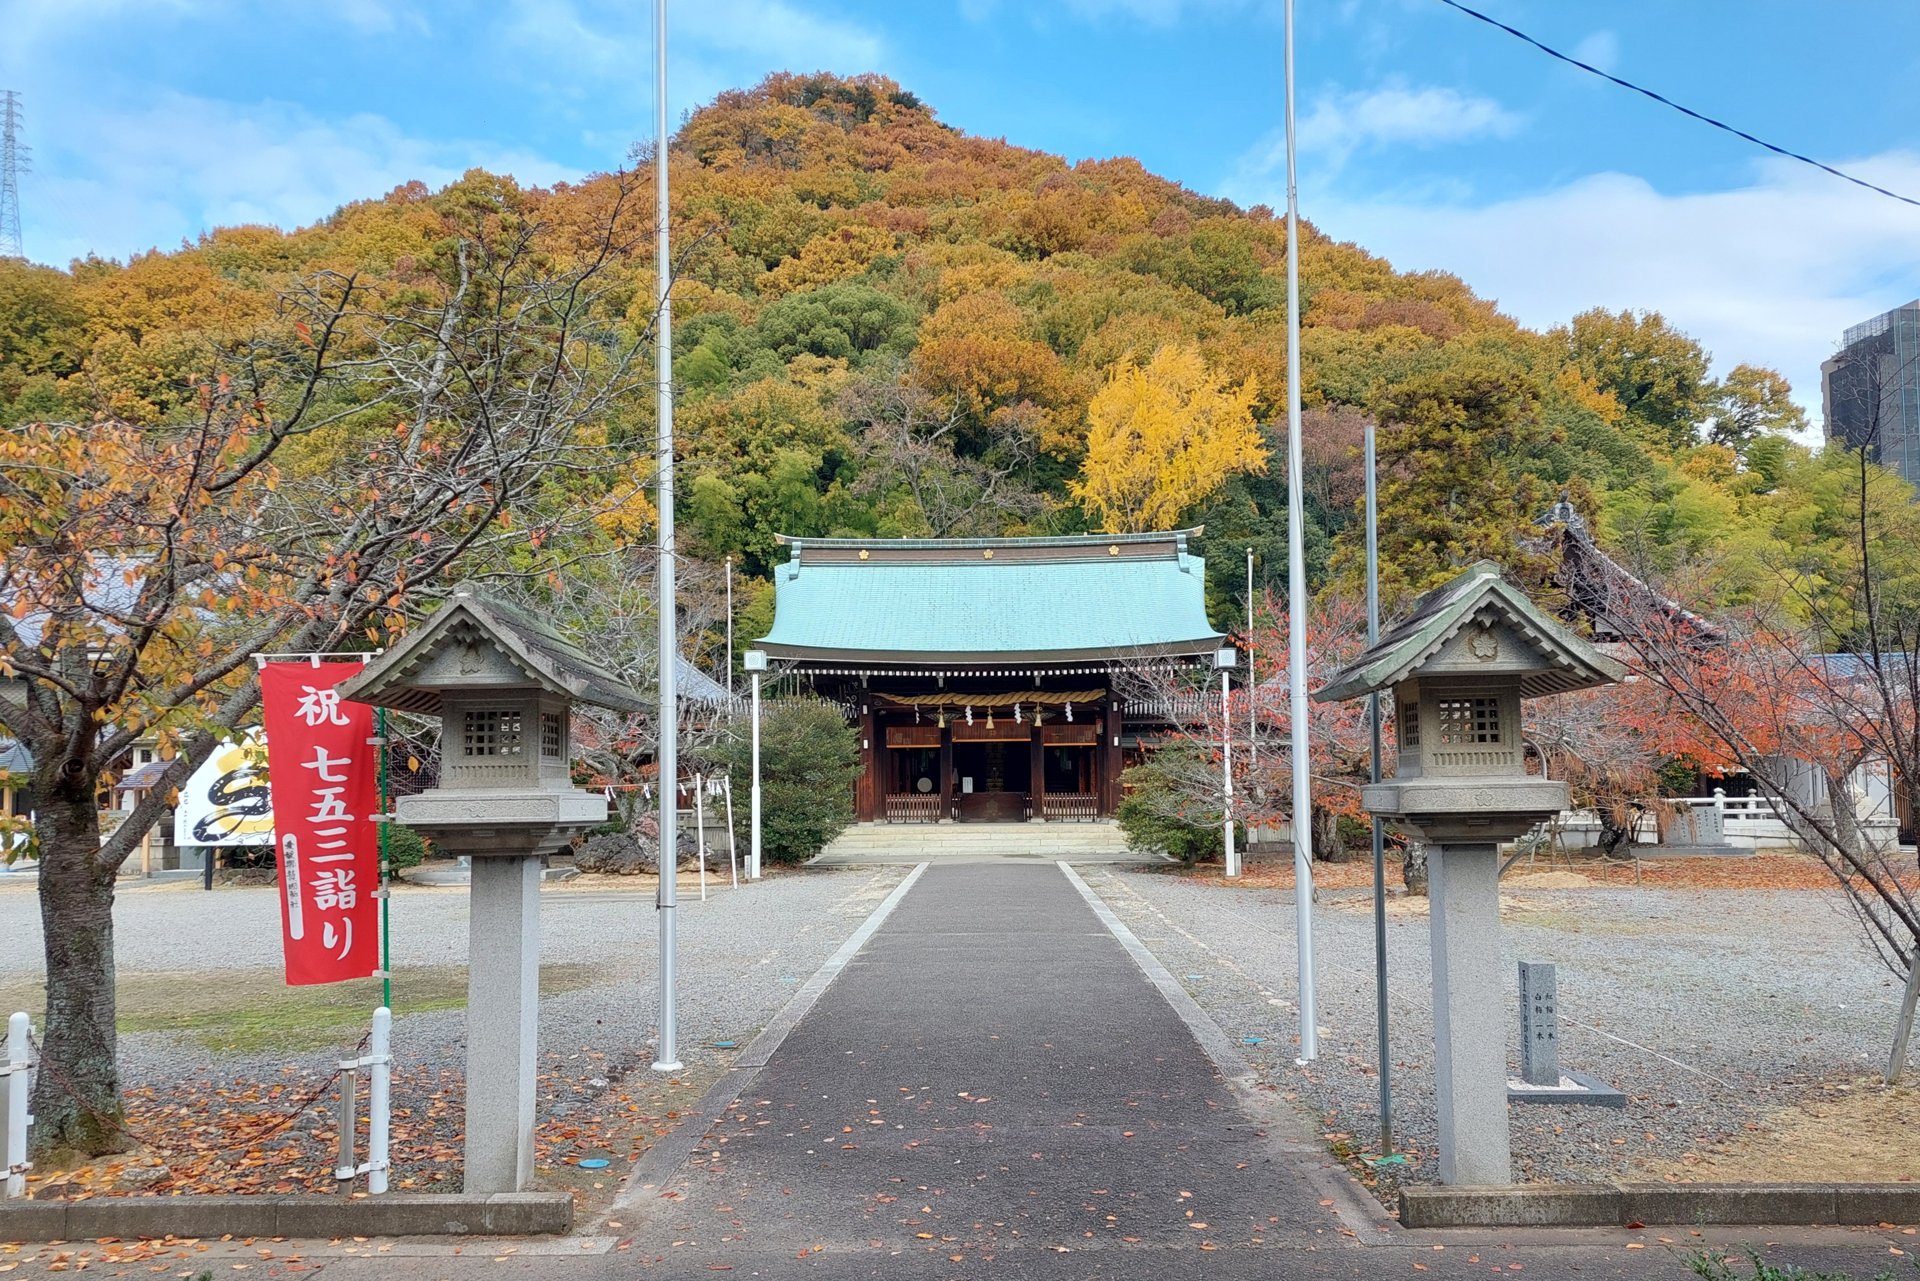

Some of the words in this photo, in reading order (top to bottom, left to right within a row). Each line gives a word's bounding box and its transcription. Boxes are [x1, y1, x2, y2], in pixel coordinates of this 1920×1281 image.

[293, 684, 351, 727] 祝
[300, 744, 357, 962] 七五三詣り
